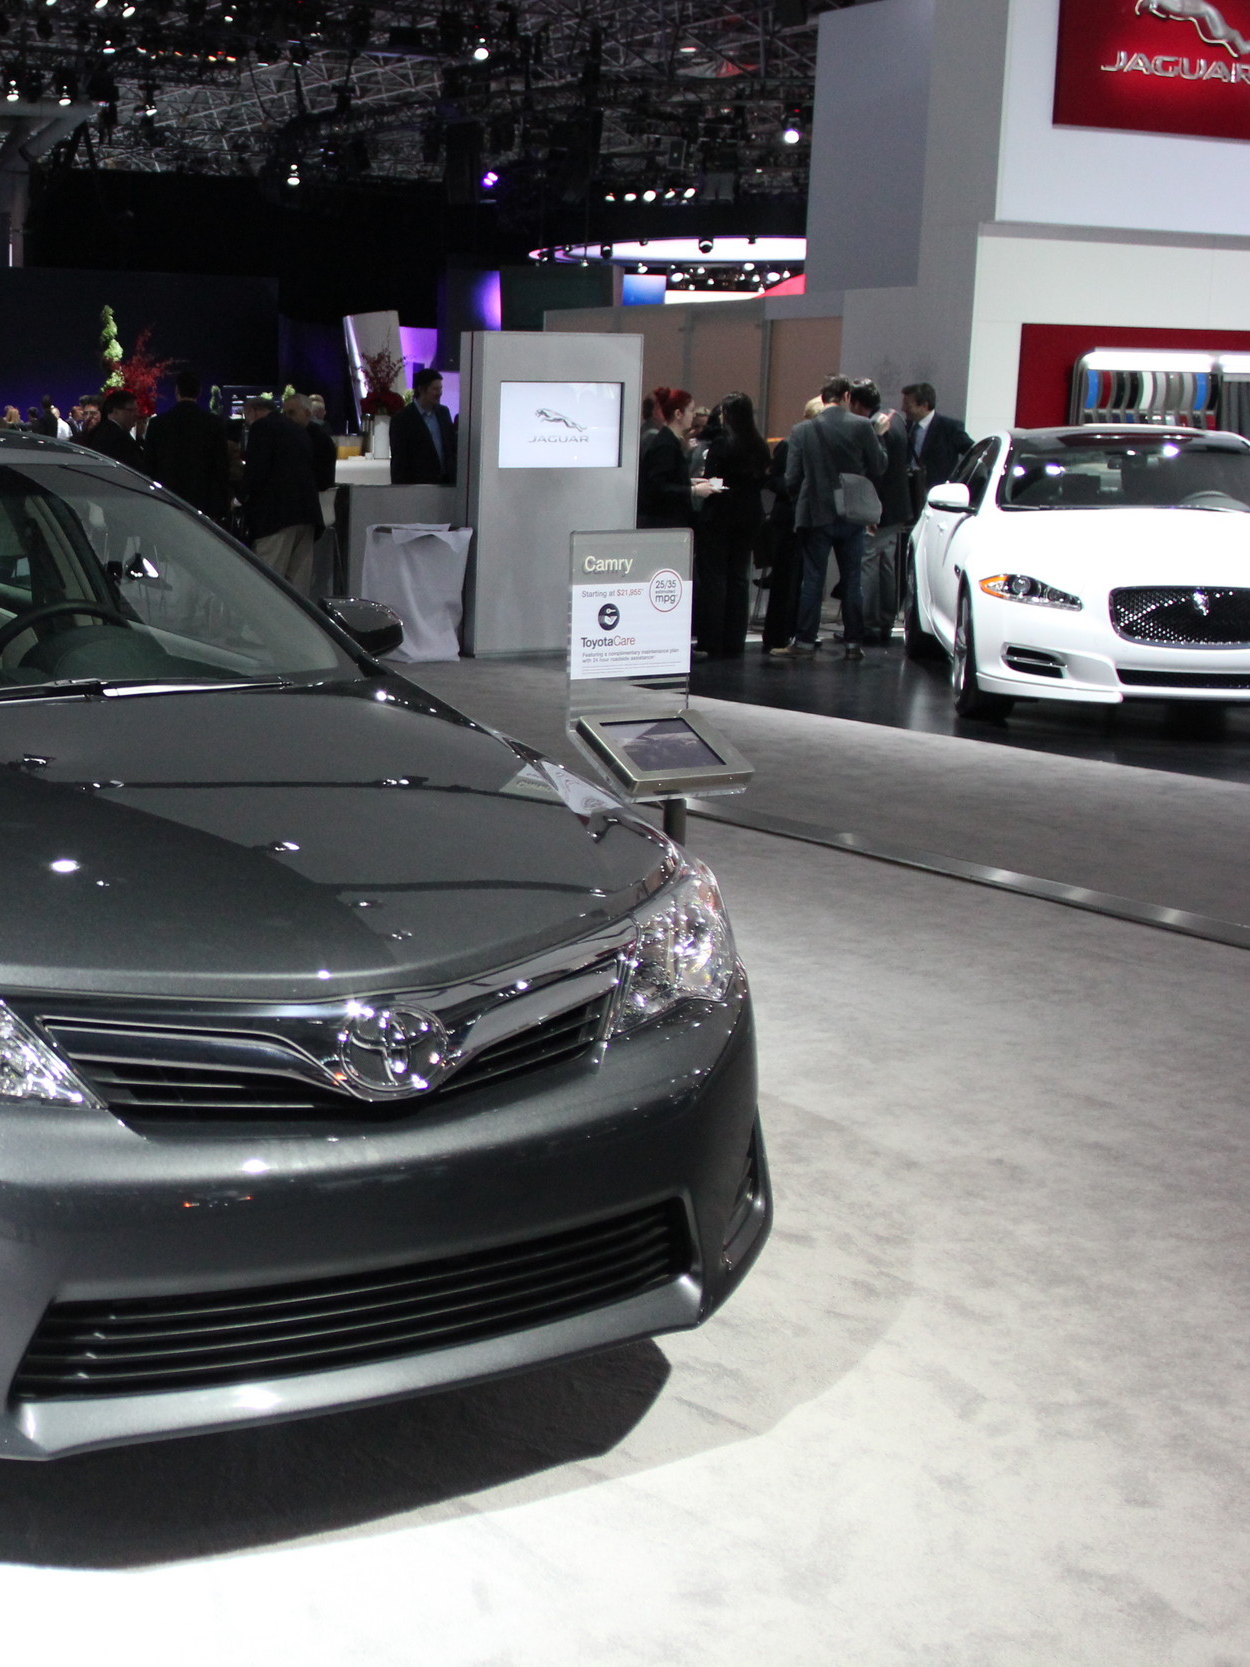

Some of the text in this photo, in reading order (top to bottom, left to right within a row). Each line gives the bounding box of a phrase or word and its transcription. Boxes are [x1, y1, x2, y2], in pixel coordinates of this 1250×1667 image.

[1100, 50, 1250, 84] JAGUAR
[527, 435, 590, 444] JAGUAR
[584, 555, 633, 574] Camry
[655, 579, 677, 589] 25/35
[581, 590, 608, 599] Starting
[608, 589, 616, 597] at
[655, 594, 676, 604] mpg
[580, 635, 636, 649] ToyotaCare
